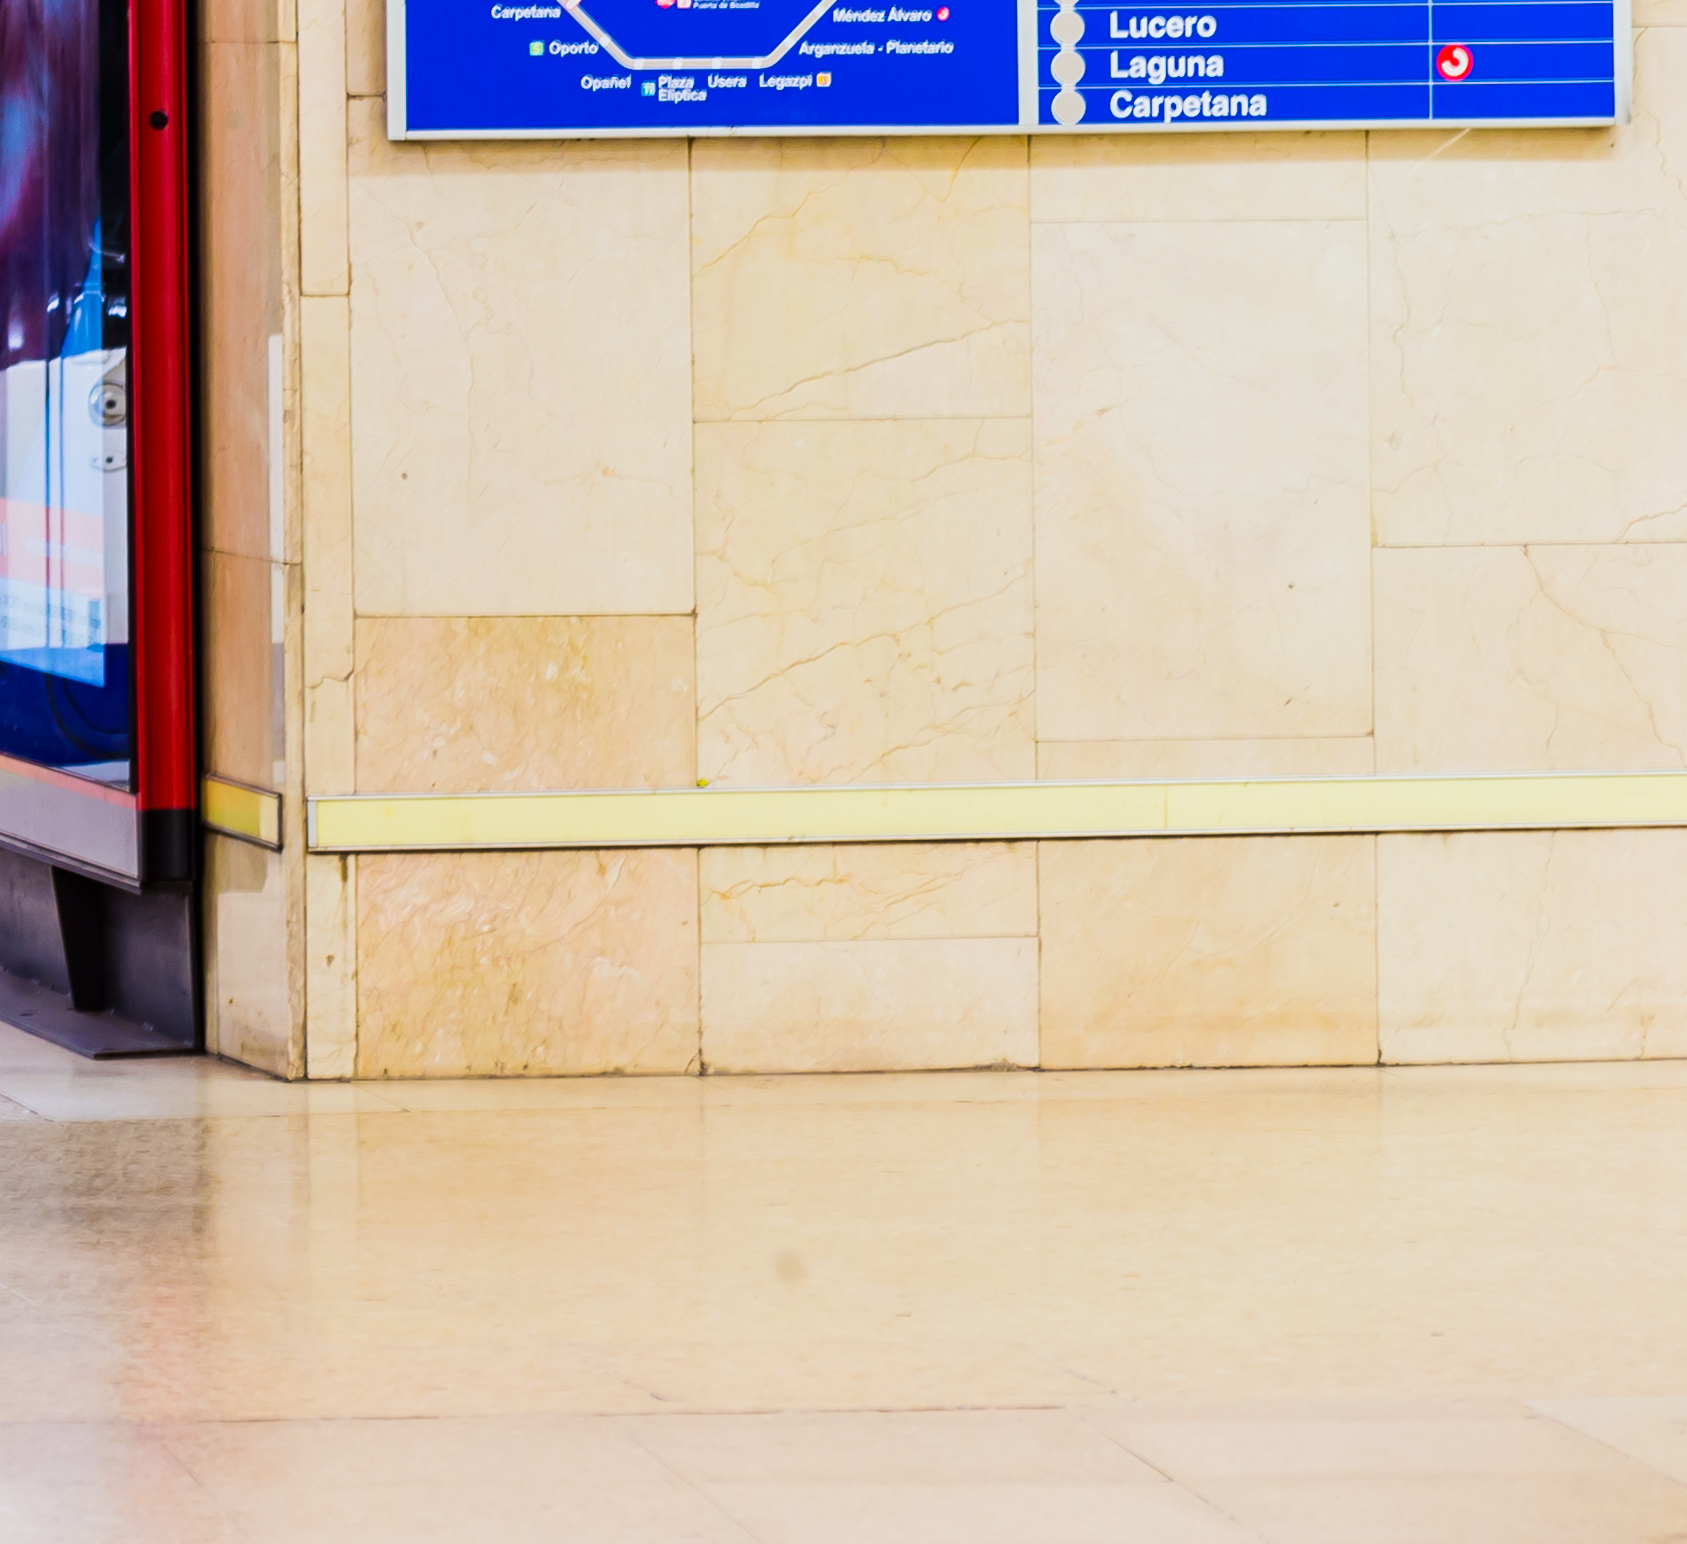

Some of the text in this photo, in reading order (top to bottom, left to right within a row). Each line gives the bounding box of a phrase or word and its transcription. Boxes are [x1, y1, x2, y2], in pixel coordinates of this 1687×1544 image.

[491, 4, 561, 21] Carpetana
[833, 5, 933, 22] Méndez Álvaro
[1110, 11, 1217, 38] Lucero
[549, 40, 599, 57] Oporto
[799, 40, 875, 57] Arganzuela
[886, 40, 954, 55] Planetario
[1110, 51, 1223, 84] Laguna
[581, 74, 631, 91] Opañel
[658, 75, 694, 88] Plaza
[707, 74, 747, 88] Usera
[759, 73, 813, 90] Legazpi
[1110, 92, 1267, 123] Carpetana
